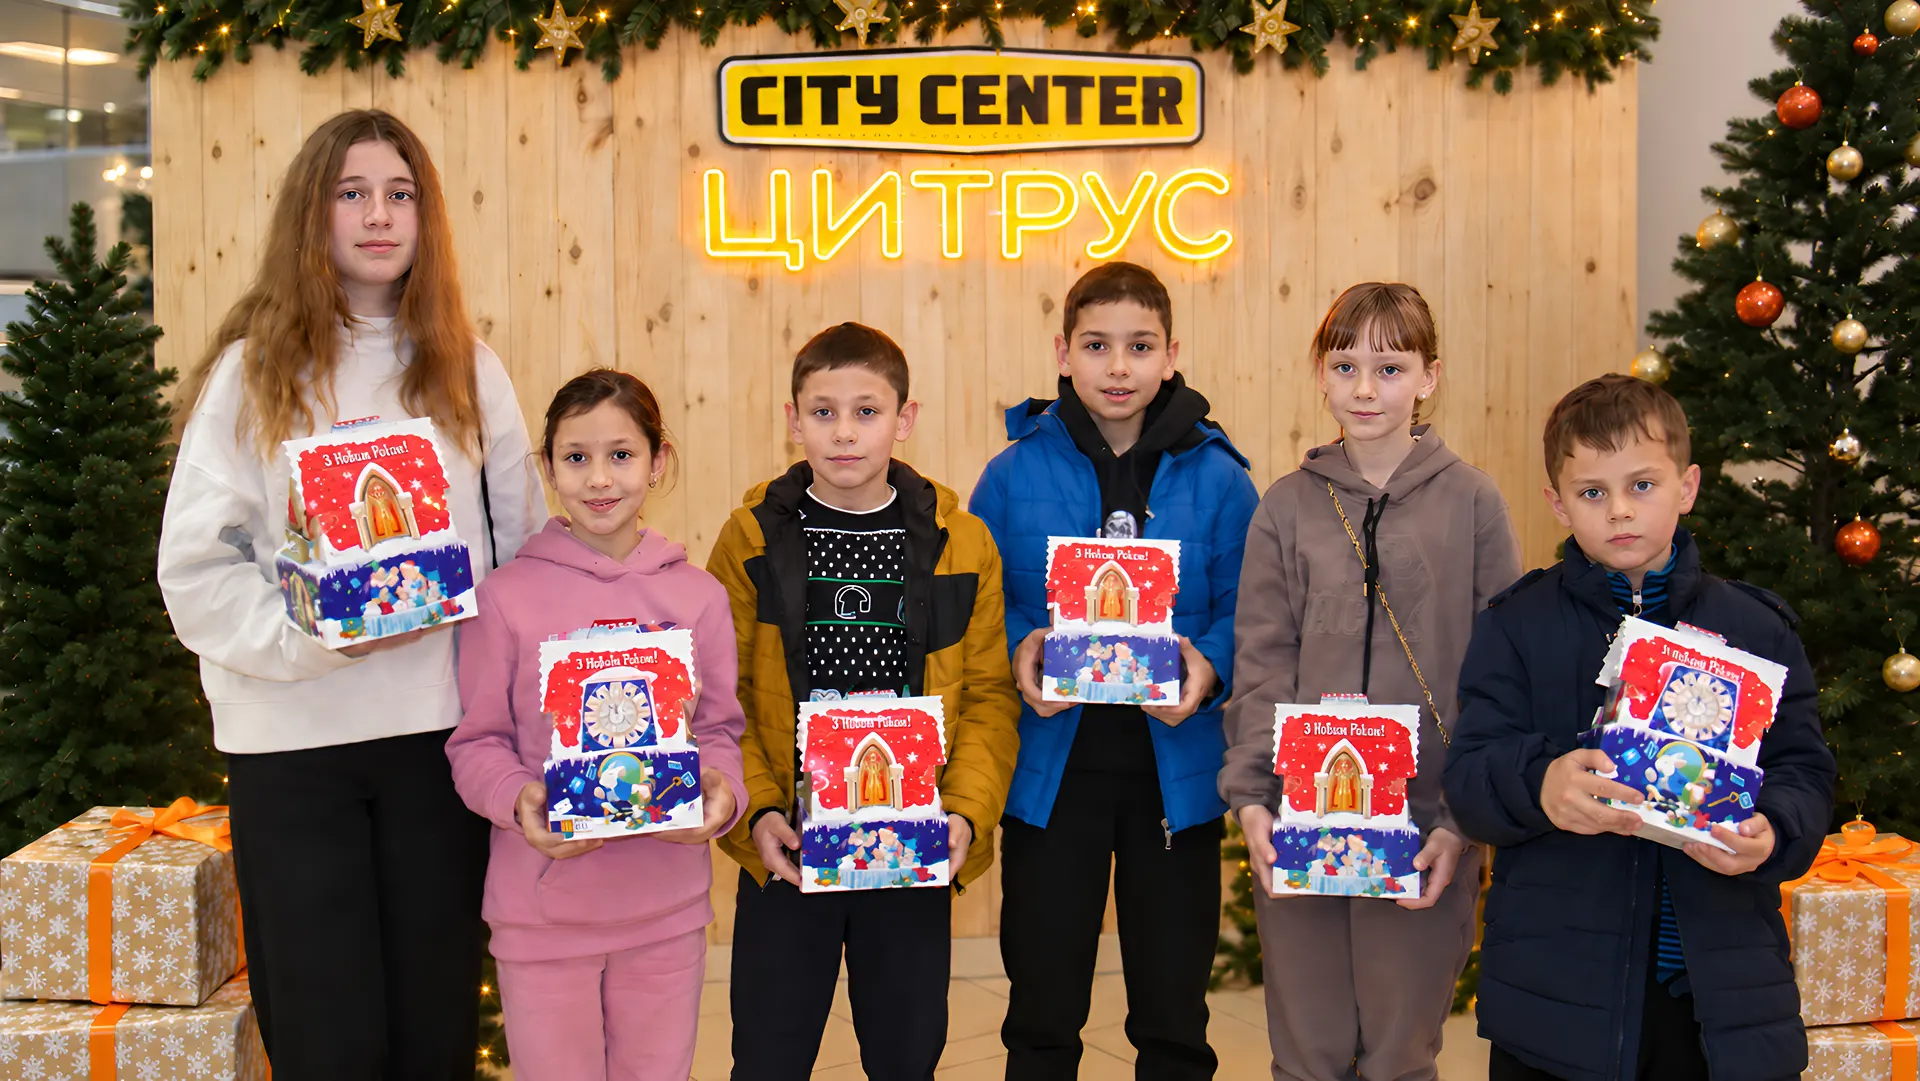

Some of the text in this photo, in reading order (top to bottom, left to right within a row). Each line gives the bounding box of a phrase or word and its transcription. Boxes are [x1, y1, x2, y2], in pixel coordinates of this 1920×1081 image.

[740, 74, 1184, 126] CITY CENTER
[703, 169, 1233, 271] ЦИТРУС
